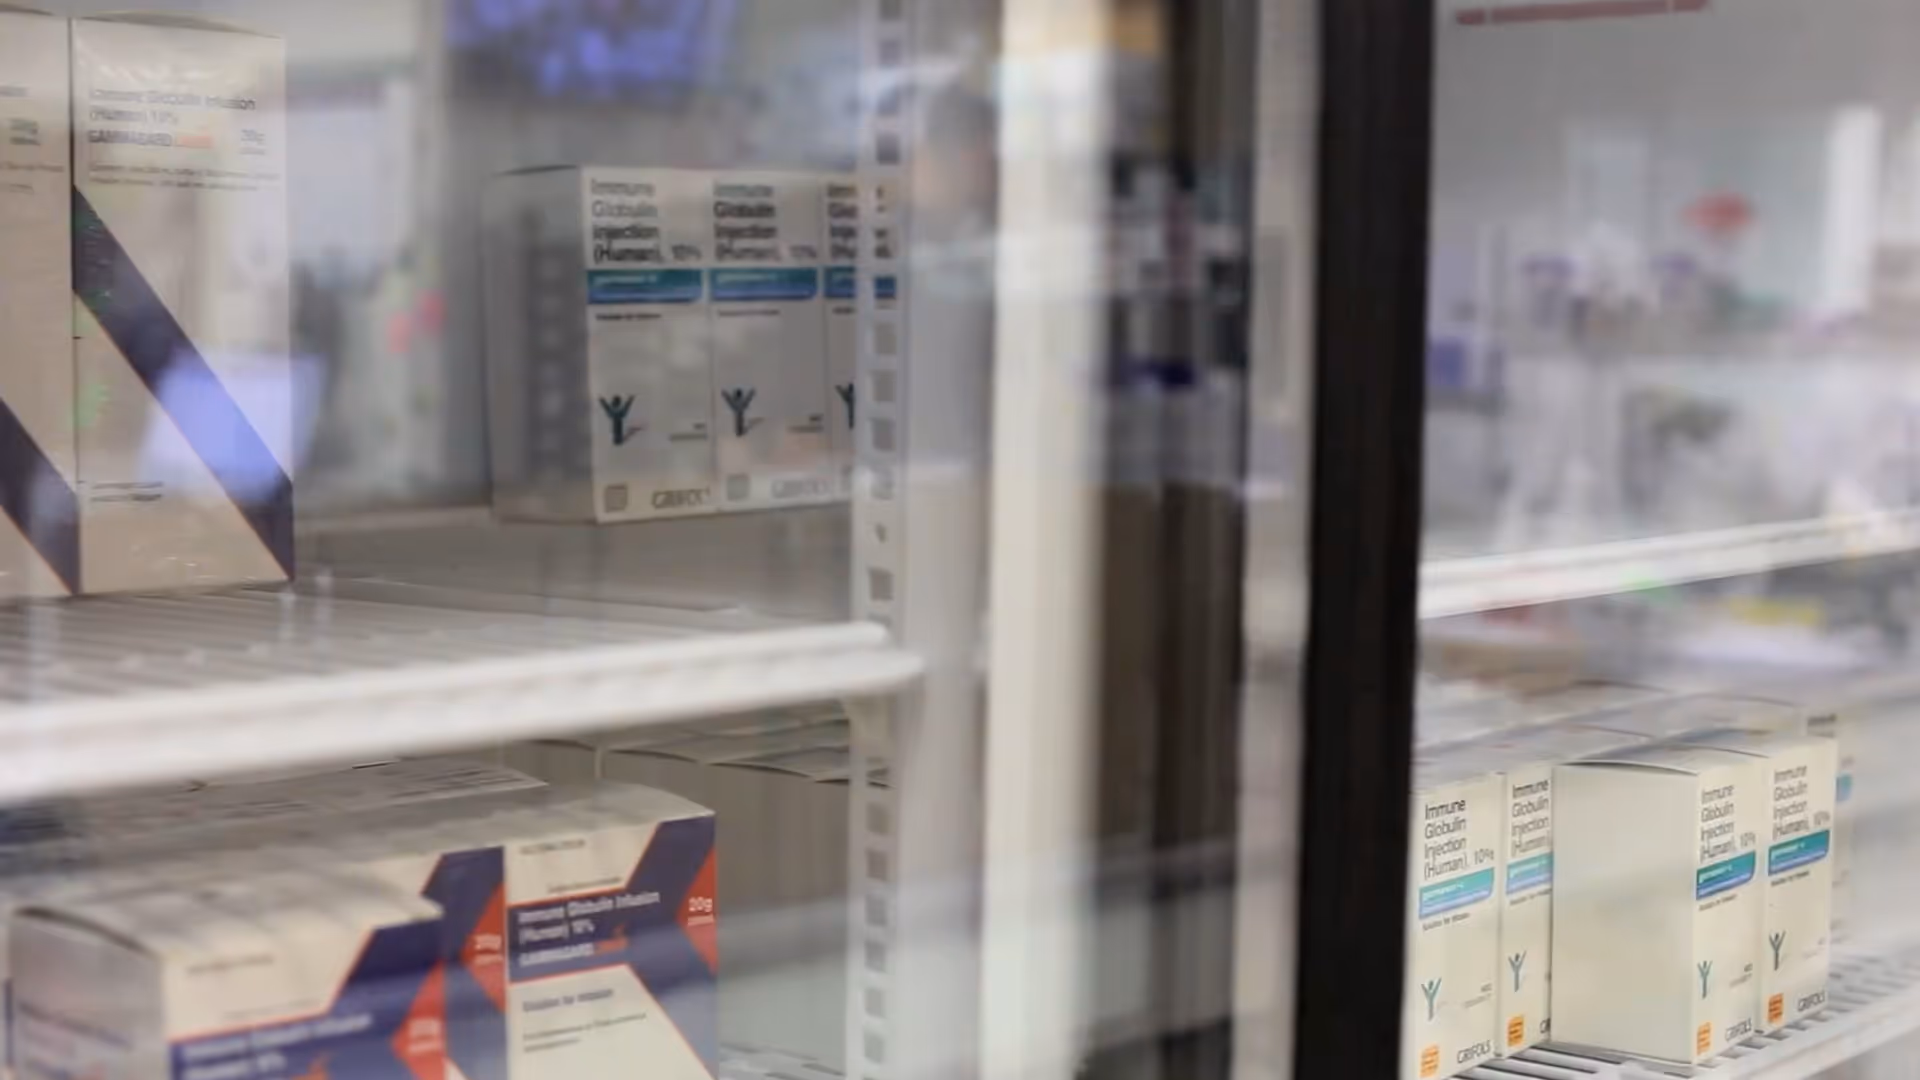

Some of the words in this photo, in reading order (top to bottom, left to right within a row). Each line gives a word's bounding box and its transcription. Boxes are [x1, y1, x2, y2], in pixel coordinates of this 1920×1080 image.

[1512, 780, 1549, 799] Immune
[1424, 800, 1467, 820] Immune
[1424, 817, 1467, 839] Globulin
[1424, 837, 1467, 864] Injection
[688, 897, 713, 913] 20g
